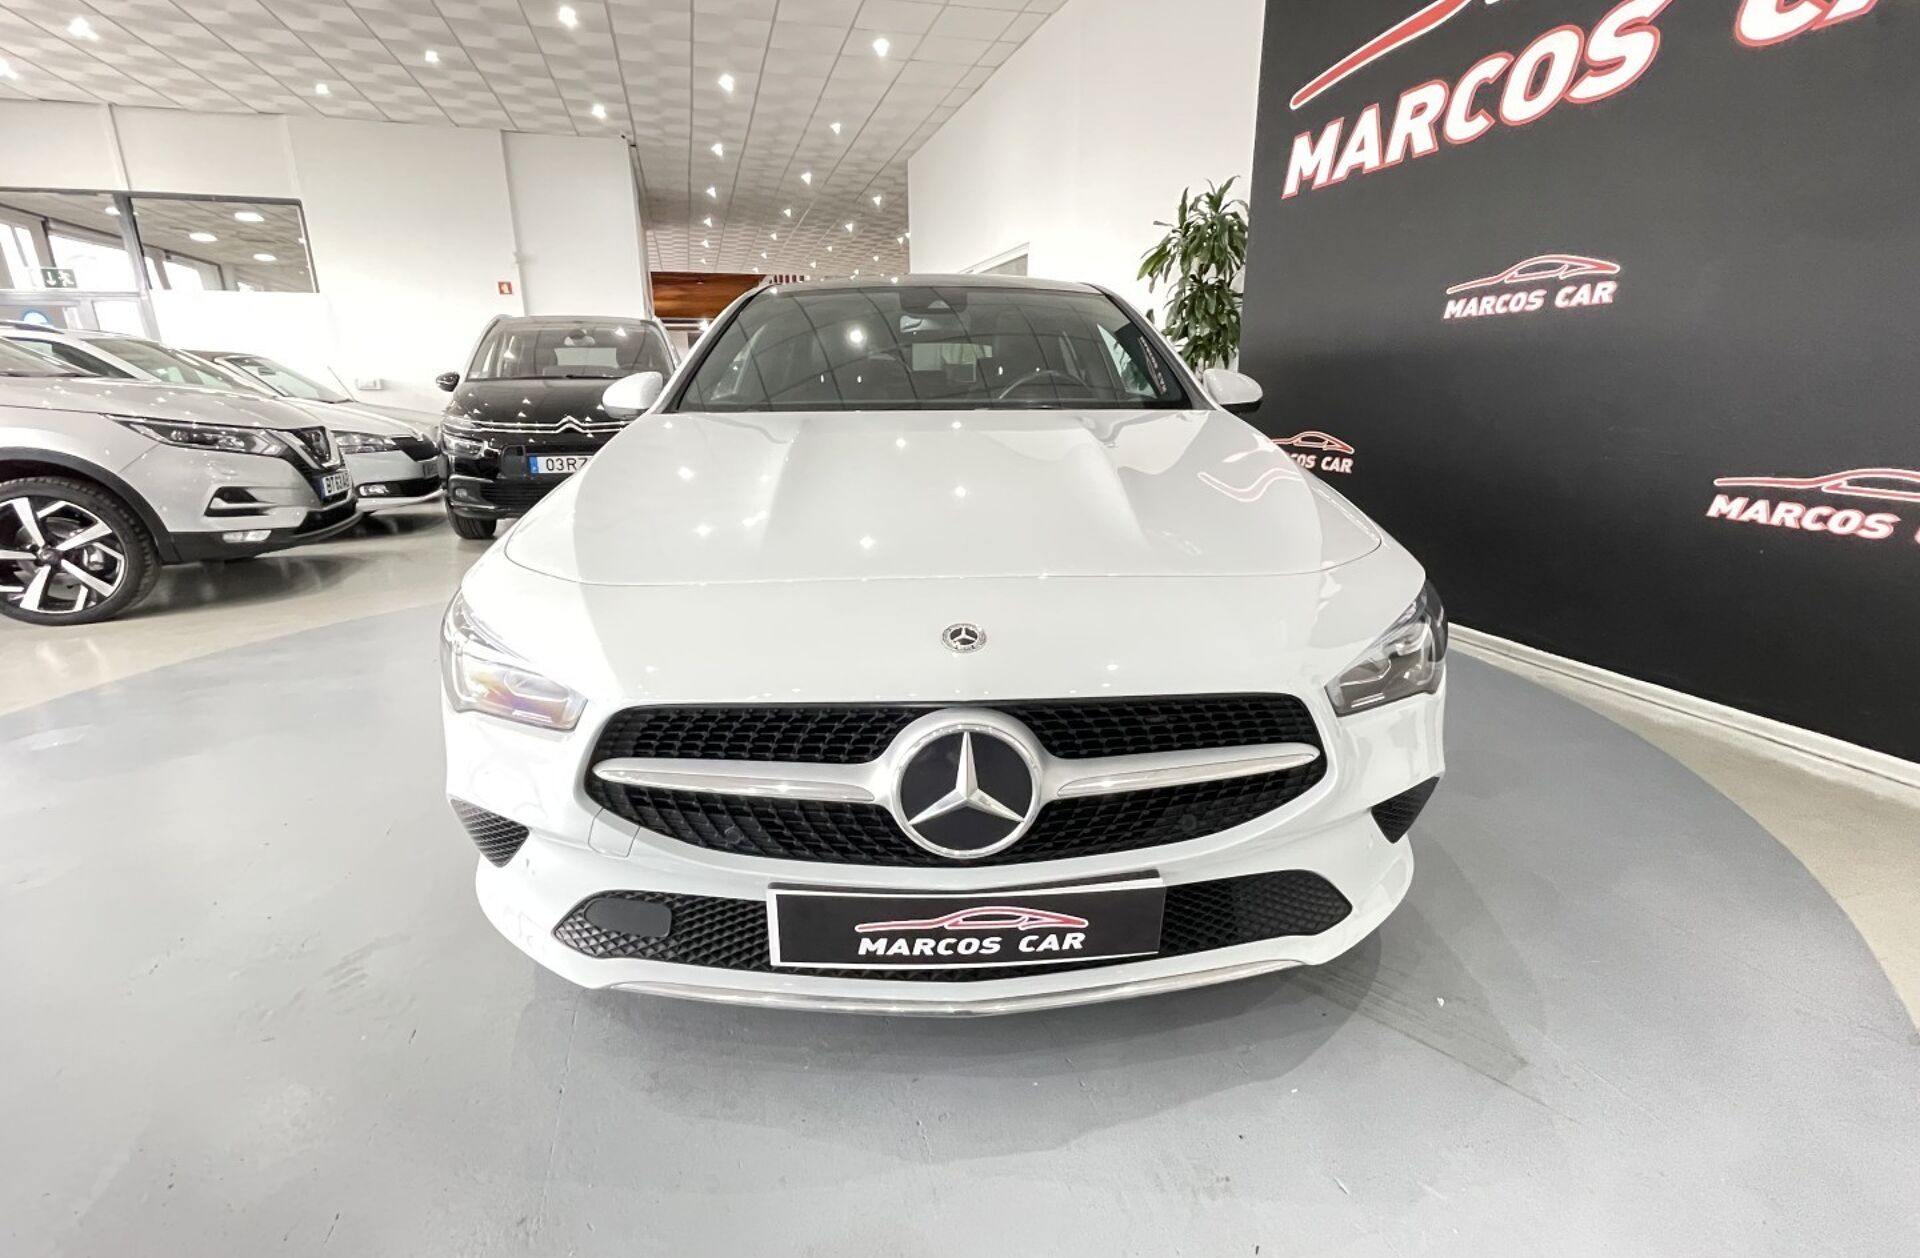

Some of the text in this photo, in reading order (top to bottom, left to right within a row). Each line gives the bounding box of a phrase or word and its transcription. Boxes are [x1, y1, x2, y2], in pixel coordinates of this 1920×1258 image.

[1281, 0, 1674, 199] MARCOS
[1443, 280, 1617, 319] MARCOS CAR
[1321, 456, 1354, 473] CAR
[1706, 494, 1900, 539] MARCOS
[858, 932, 1086, 956] MARCOS CAR
